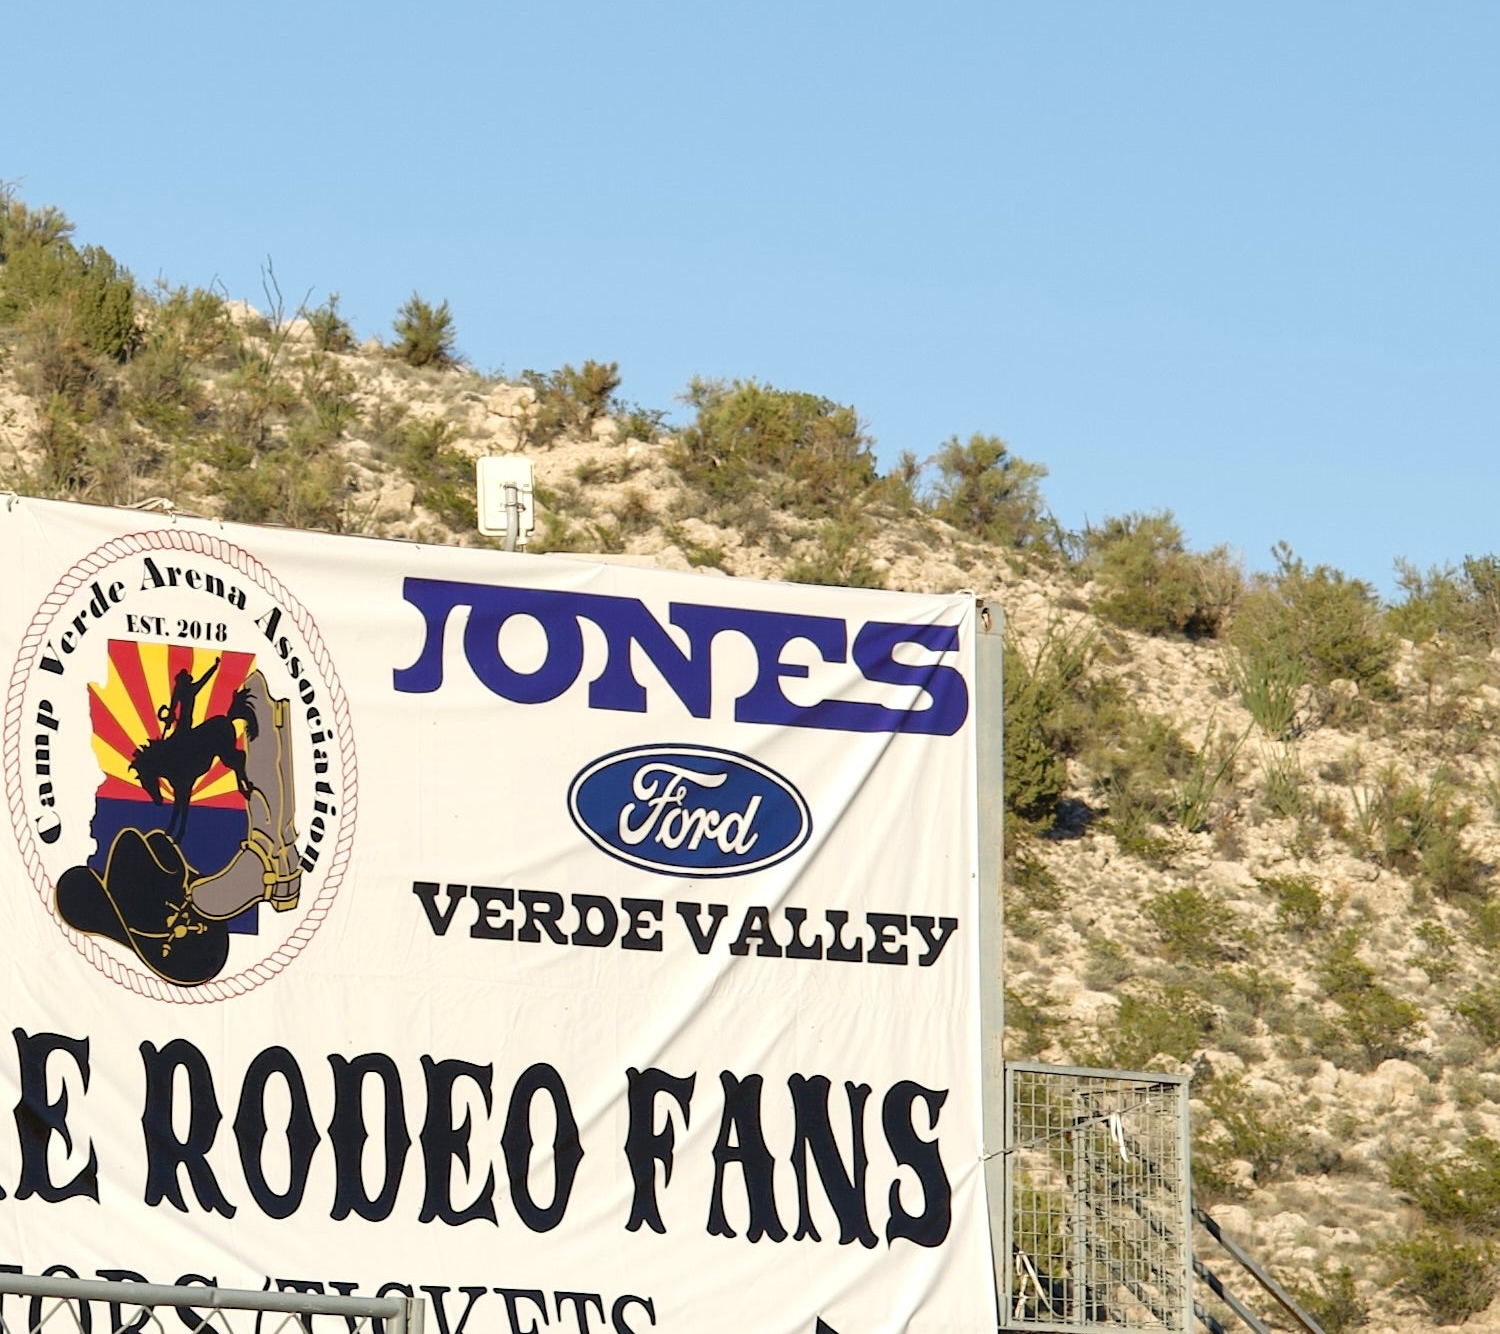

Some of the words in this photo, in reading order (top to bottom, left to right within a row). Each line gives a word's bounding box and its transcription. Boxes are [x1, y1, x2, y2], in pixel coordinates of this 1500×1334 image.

[38, 577, 126, 677] Verde
[126, 614, 171, 638] EST.
[177, 619, 228, 643] 2018
[139, 557, 247, 611] Arena
[393, 577, 969, 736] JONES
[34, 700, 61, 844] Camp
[254, 606, 337, 874] Association
[619, 762, 763, 855] Ford
[412, 881, 663, 952] VERDE
[676, 901, 958, 967] VALLEY
[139, 1038, 585, 1233] RODEO
[624, 1067, 952, 1249] FANS
